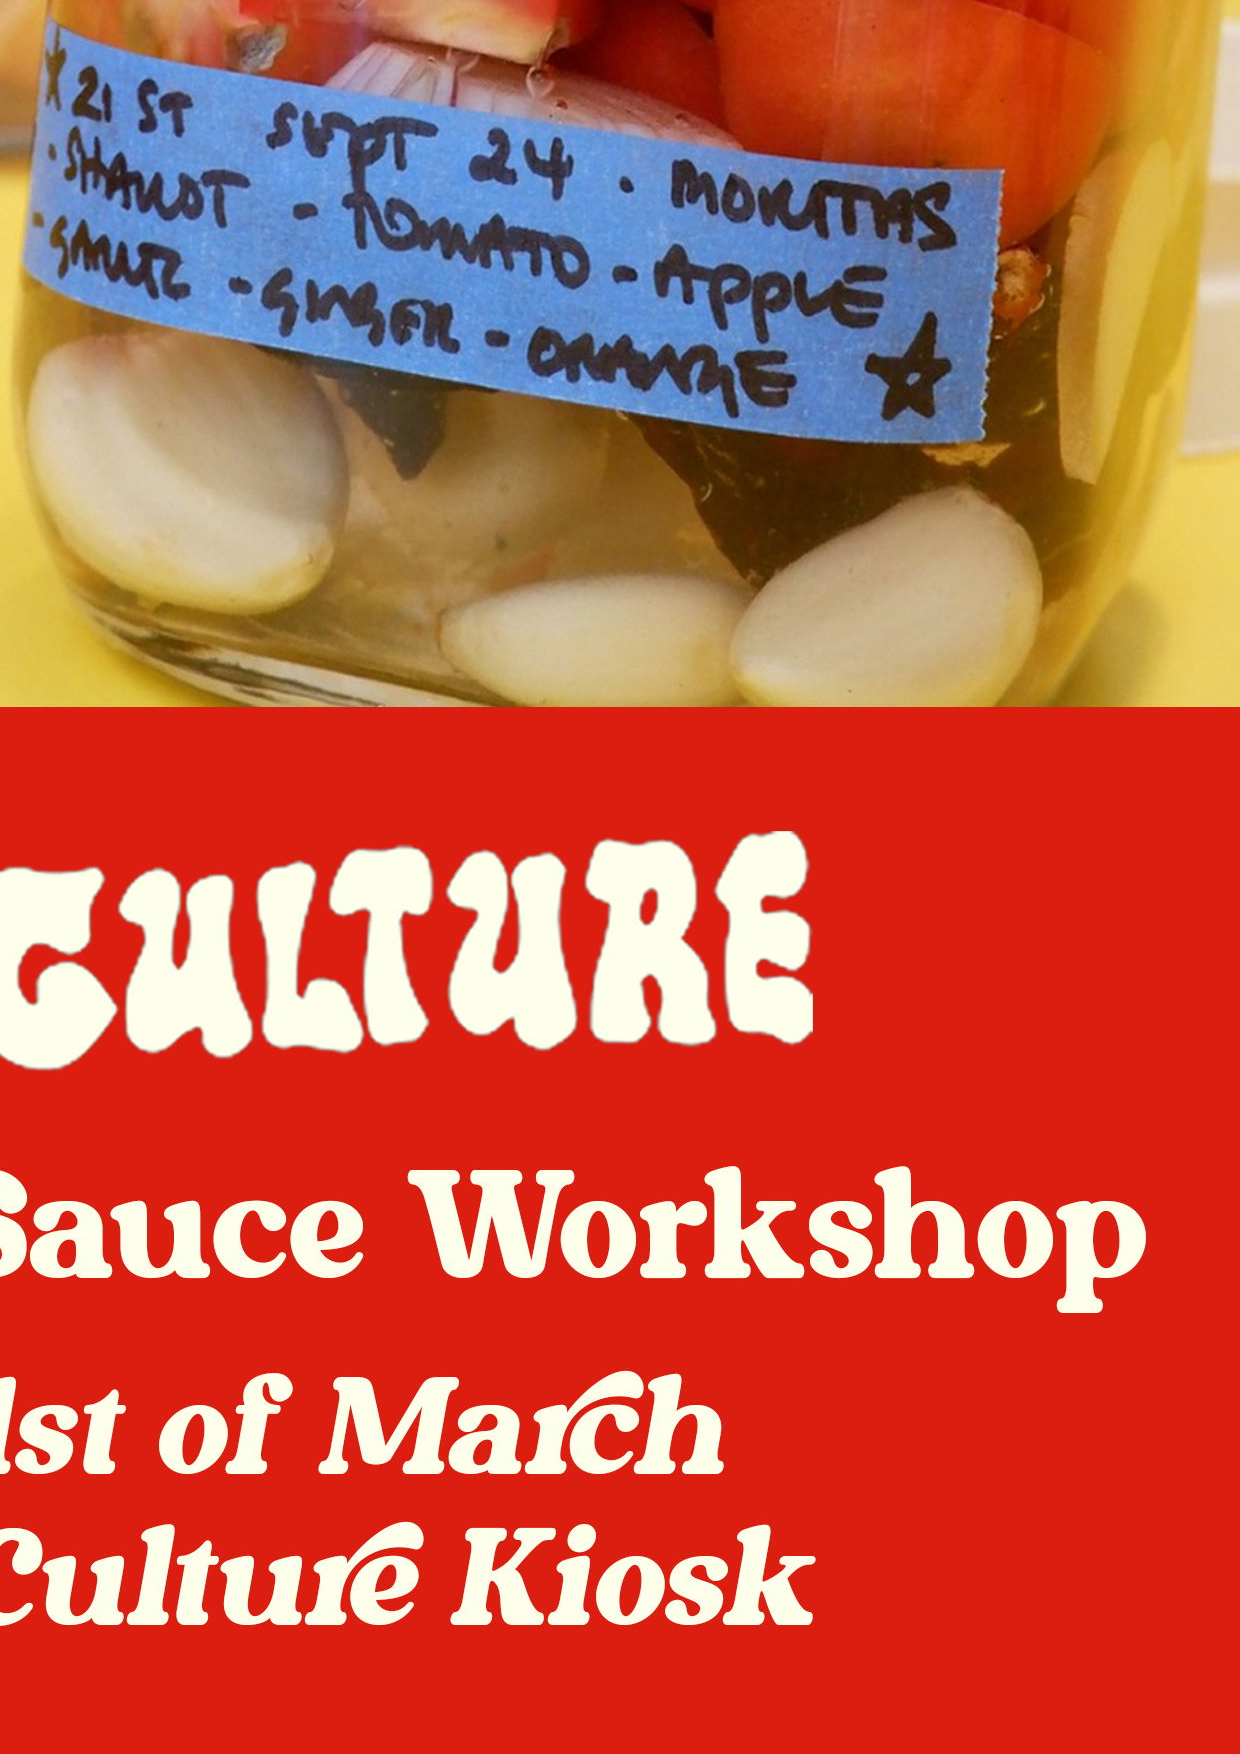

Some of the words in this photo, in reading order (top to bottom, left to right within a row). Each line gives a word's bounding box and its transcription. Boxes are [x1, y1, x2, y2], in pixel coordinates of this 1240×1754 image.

[71, 65, 112, 123] 21
[469, 128, 574, 200] 24
[261, 267, 461, 353] GINGER
[527, 325, 798, 418] ORANGE
[341, 191, 591, 289] TOMATO
[653, 244, 888, 344] APPLE
